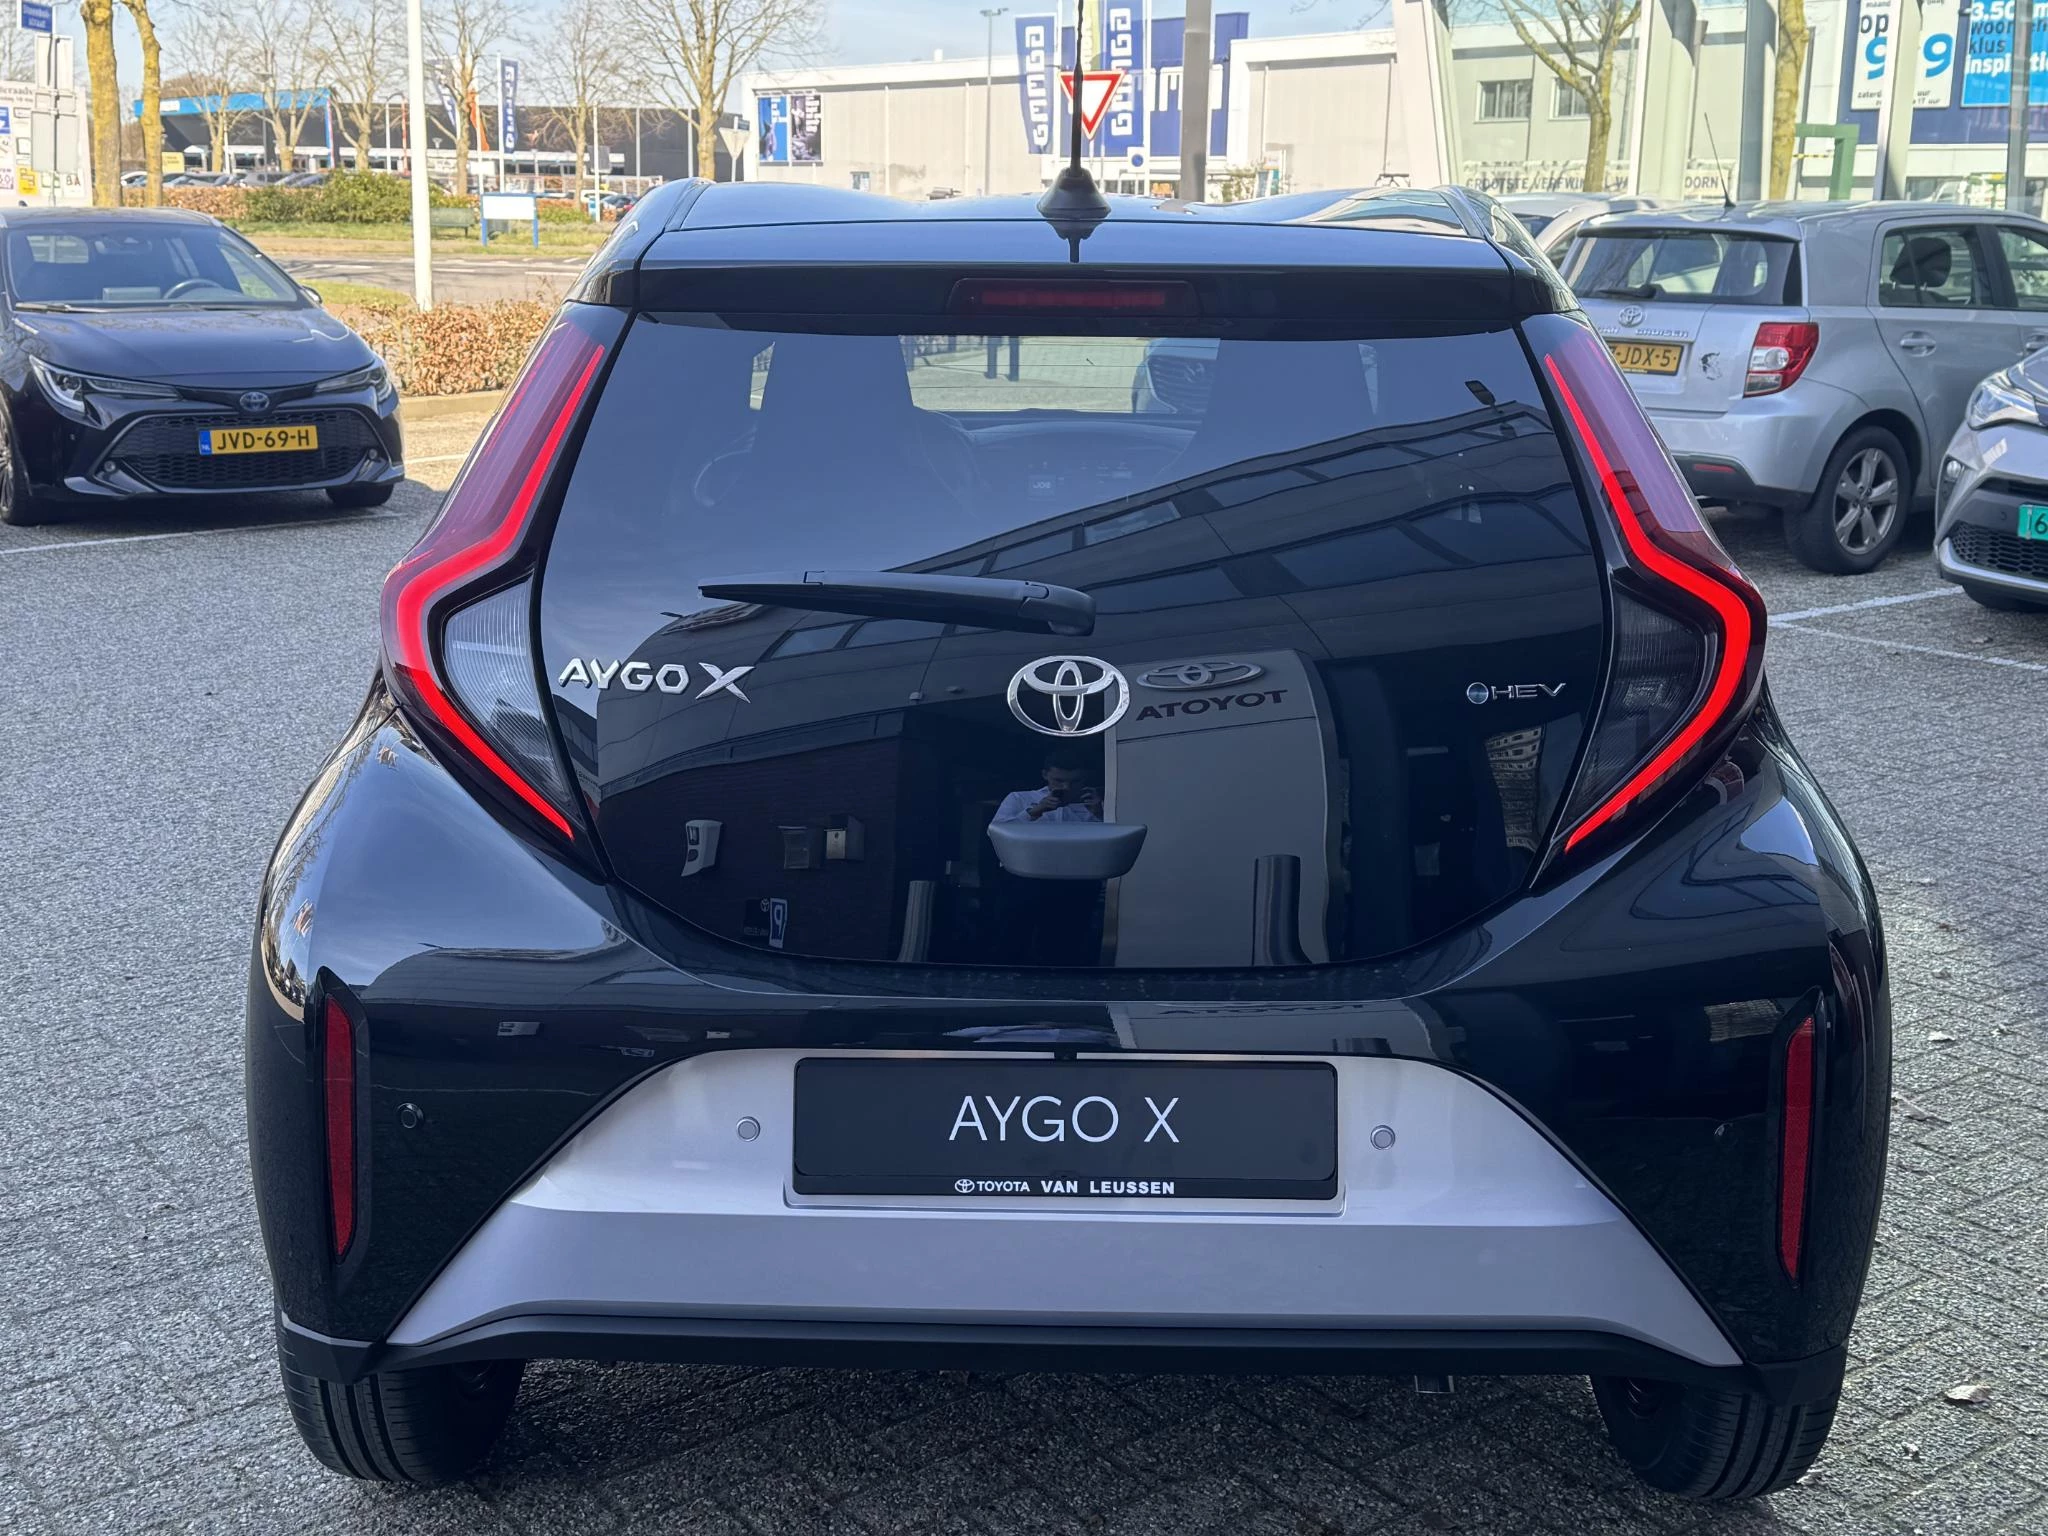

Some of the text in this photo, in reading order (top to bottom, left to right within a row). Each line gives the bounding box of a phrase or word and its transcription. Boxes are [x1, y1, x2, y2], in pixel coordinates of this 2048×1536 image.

[1923, 33, 1953, 78] 9
[1969, 37, 2007, 54] klus
[217, 428, 310, 451] JVD-69-H
[558, 657, 756, 704] AYGO X
[1491, 682, 1566, 700] HEV
[948, 1095, 1180, 1143] AYGO X
[976, 1180, 1175, 1195] TOYOTA VAN LEUSSEN
